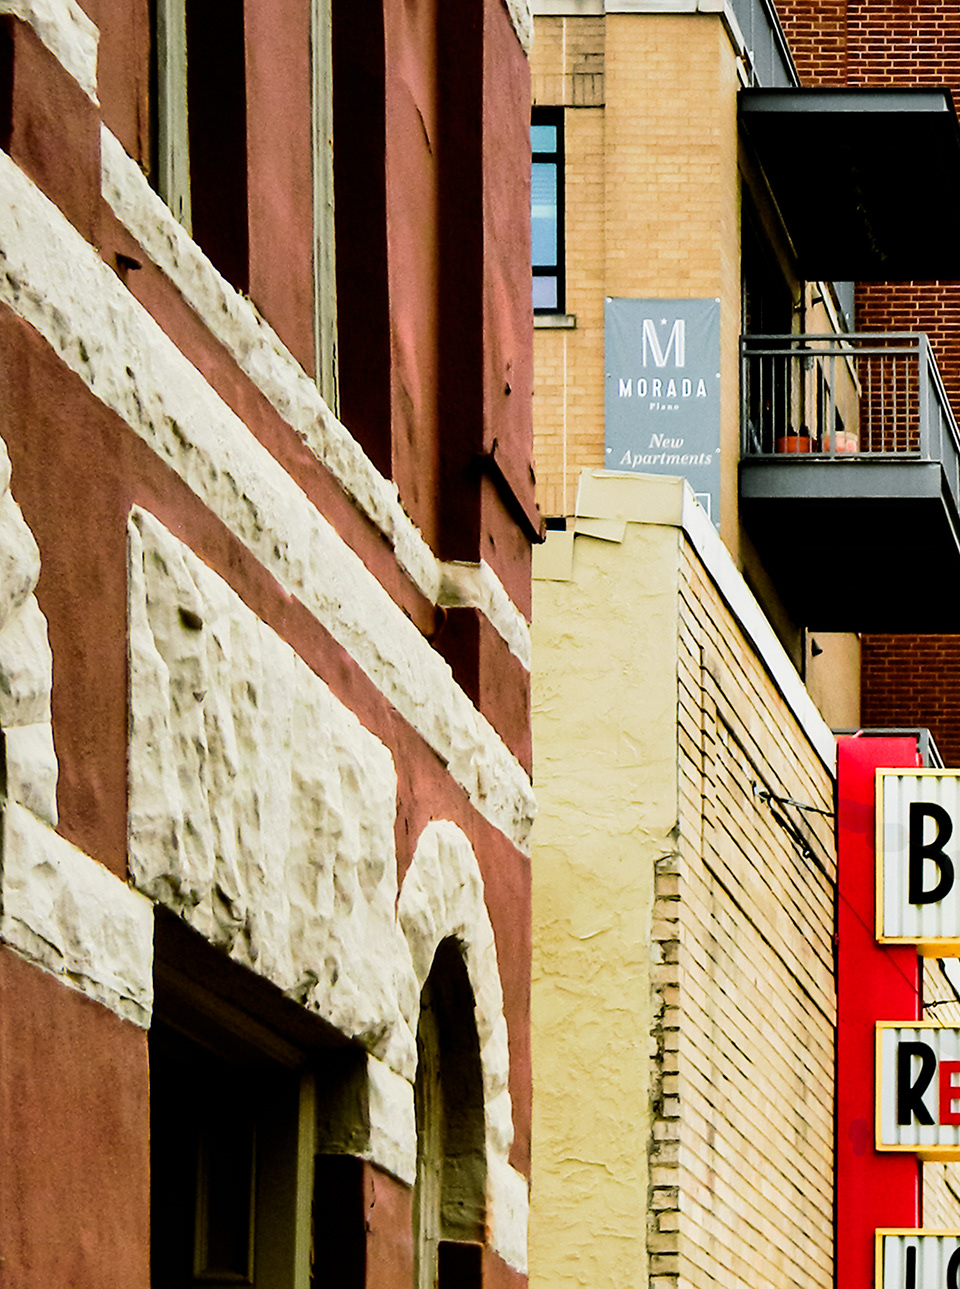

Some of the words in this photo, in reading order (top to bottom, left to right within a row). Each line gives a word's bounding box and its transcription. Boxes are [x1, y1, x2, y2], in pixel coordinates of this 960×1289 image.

[642, 319, 686, 367] M
[619, 378, 708, 398] MORADA
[649, 402, 680, 411] Plano
[649, 433, 684, 449] New
[620, 451, 712, 468] Apartments
